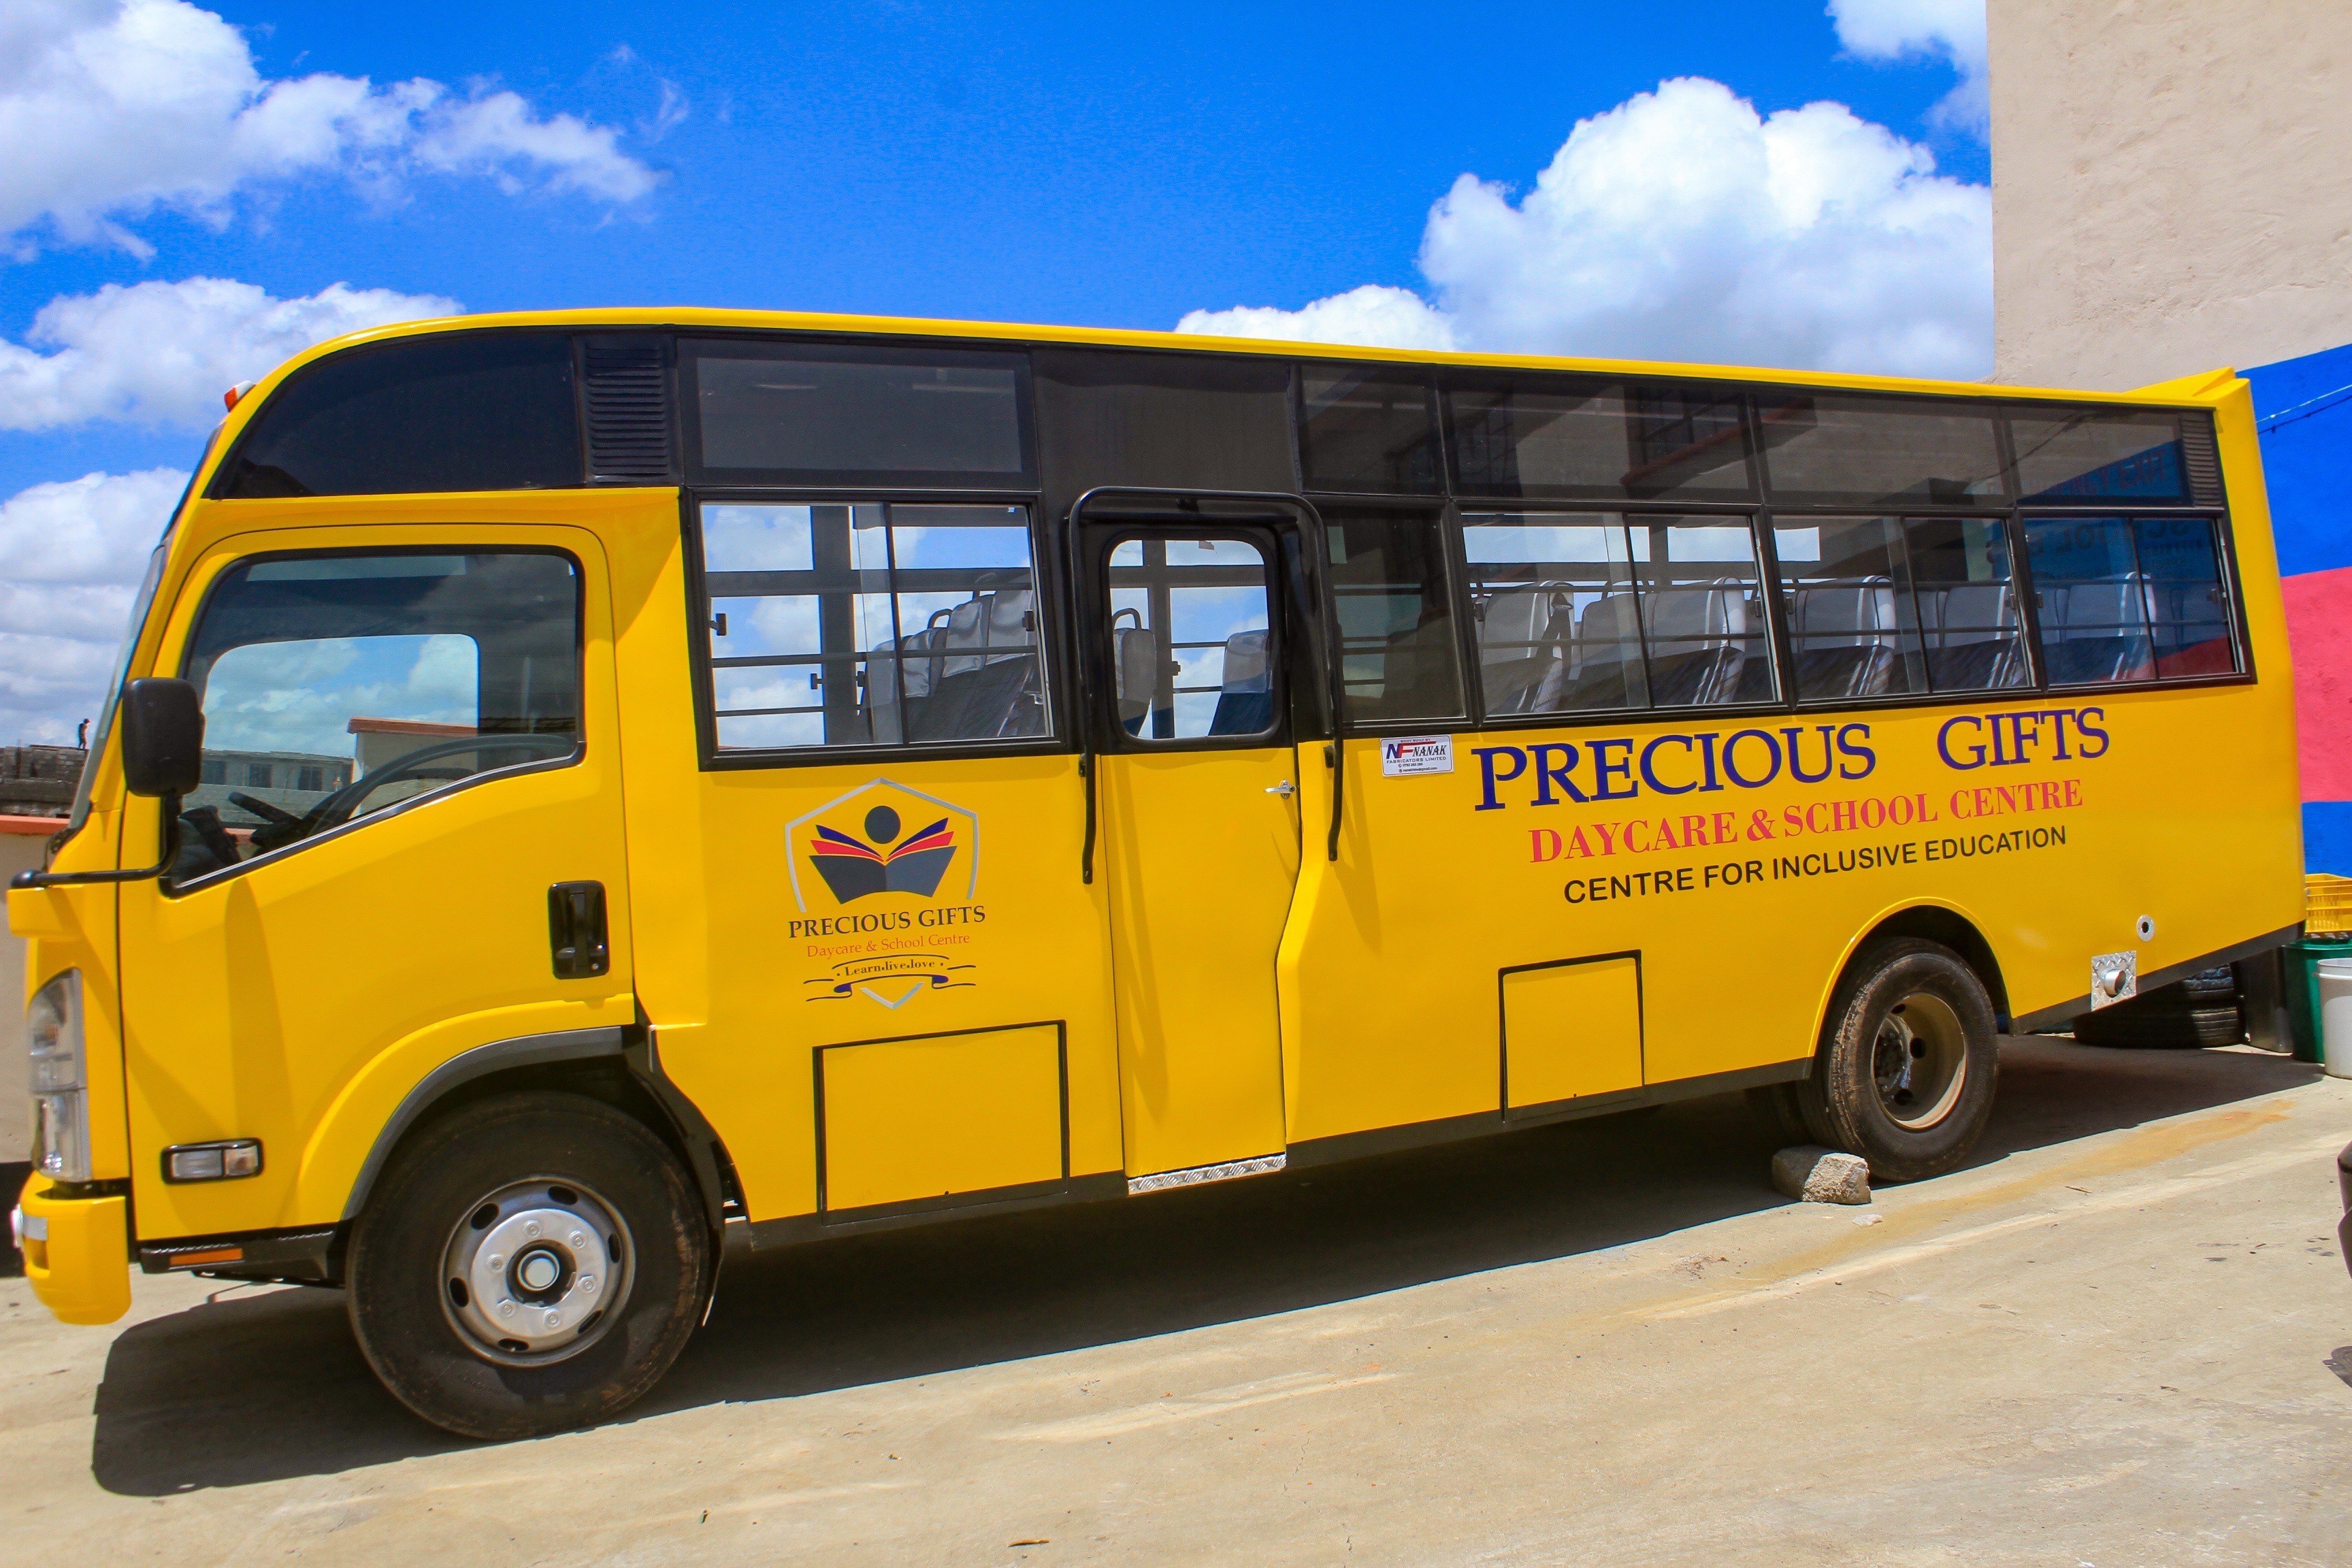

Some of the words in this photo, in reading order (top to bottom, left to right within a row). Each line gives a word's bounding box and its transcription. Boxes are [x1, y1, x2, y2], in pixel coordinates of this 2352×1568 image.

[1412, 745, 1447, 757] NANAK
[1471, 723, 1877, 811] PRECIOUS
[1936, 706, 2110, 770] GIFTS
[1528, 812, 1738, 863] DAYCARE
[1746, 809, 1777, 841] &
[1784, 793, 1938, 837] SCHOOL
[1950, 779, 2083, 819] CENTRE
[1564, 867, 1695, 904] CENTRE
[1703, 860, 1764, 888] FOR
[1773, 842, 1918, 880] INCLUSIVE
[1925, 825, 2067, 862] EDUCATION
[788, 911, 912, 938] PRECIOUS
[917, 904, 987, 928] GIFTS
[807, 941, 862, 960] Daycare
[866, 941, 877, 952] &
[881, 935, 924, 951] School
[928, 934, 970, 947] Centre
